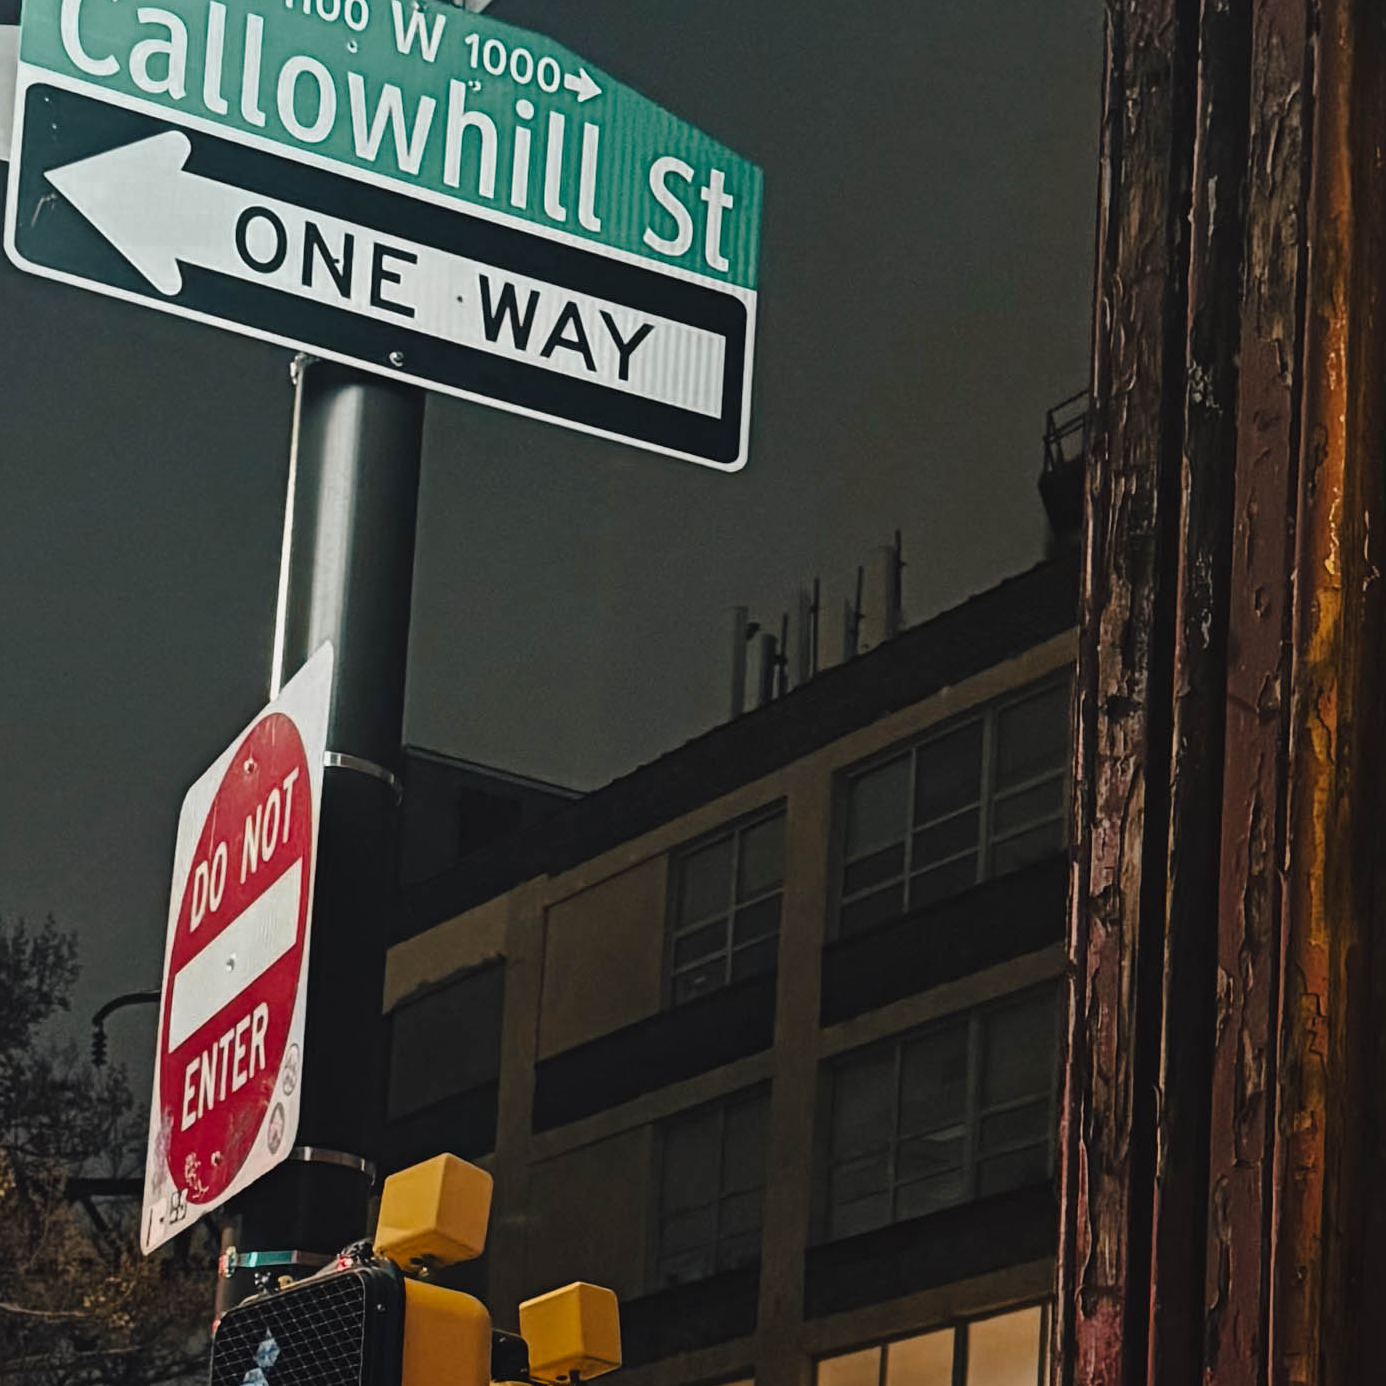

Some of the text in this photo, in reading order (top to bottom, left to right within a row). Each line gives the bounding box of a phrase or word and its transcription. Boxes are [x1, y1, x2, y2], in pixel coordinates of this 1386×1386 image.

[463, 32, 562, 94] 1000
[641, 154, 735, 273] St
[234, 205, 656, 383] ONE WAY
[189, 766, 300, 934] DO NOT
[180, 1001, 270, 1133] ENTER
